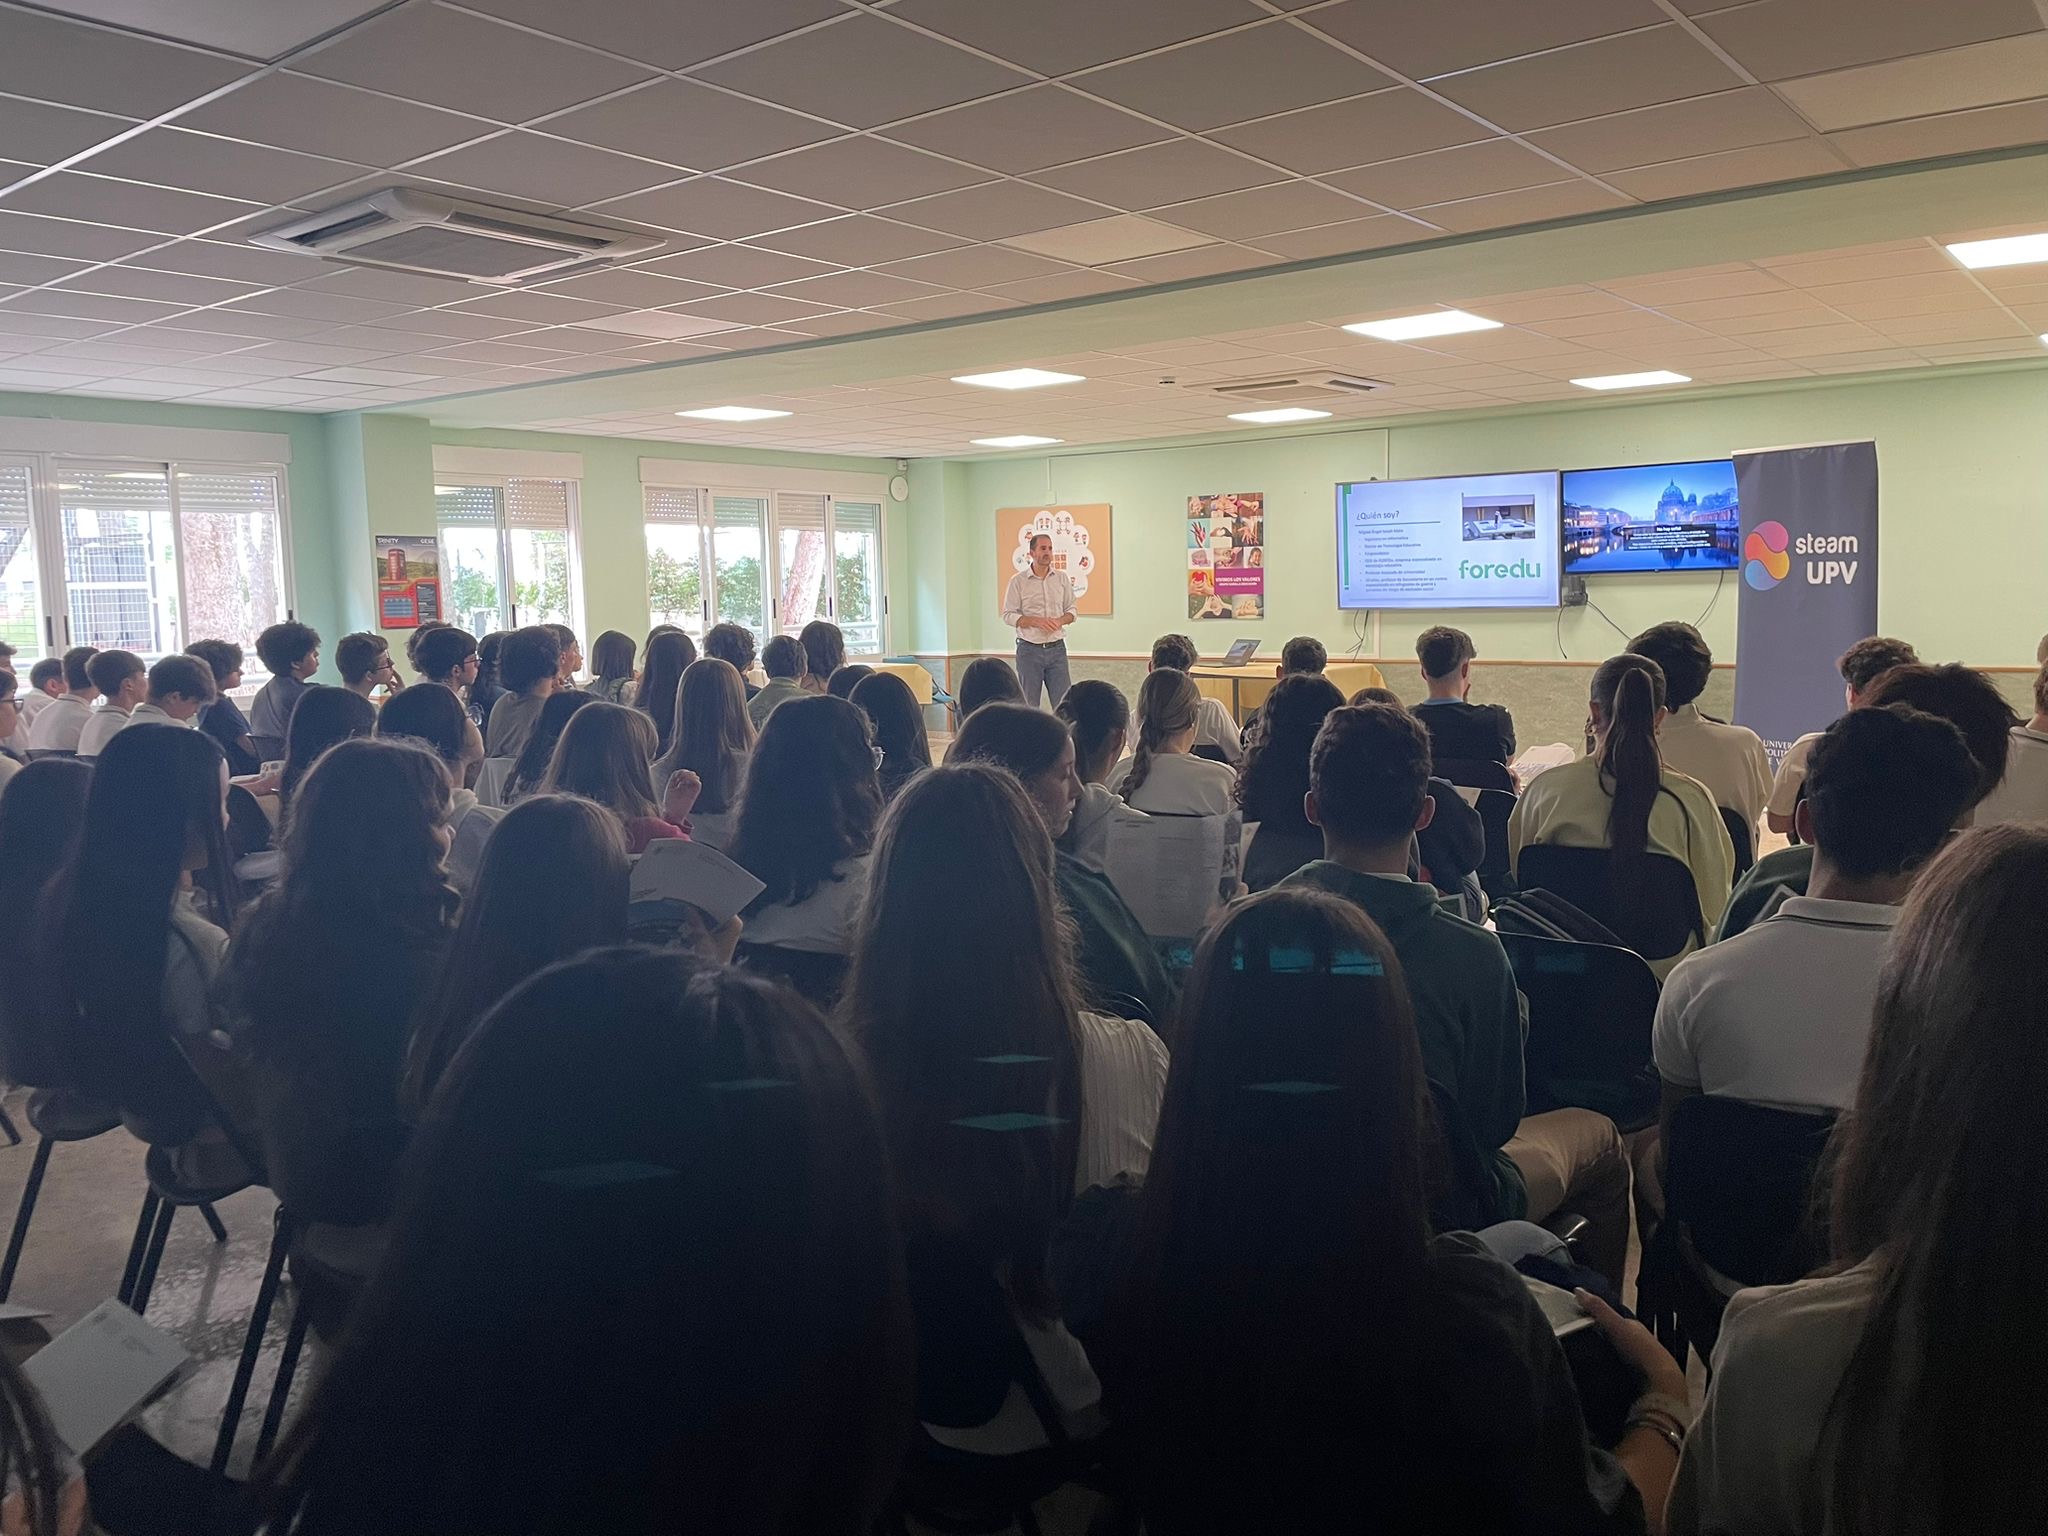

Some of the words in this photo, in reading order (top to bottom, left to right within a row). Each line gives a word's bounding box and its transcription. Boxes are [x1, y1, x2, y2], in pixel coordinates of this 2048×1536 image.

[1383, 510, 1400, 519] soy?
[1795, 532, 1858, 555] steam
[1458, 557, 1541, 579] foredu
[1806, 560, 1858, 585] UPV
[1763, 739, 1792, 750] UNIVER
